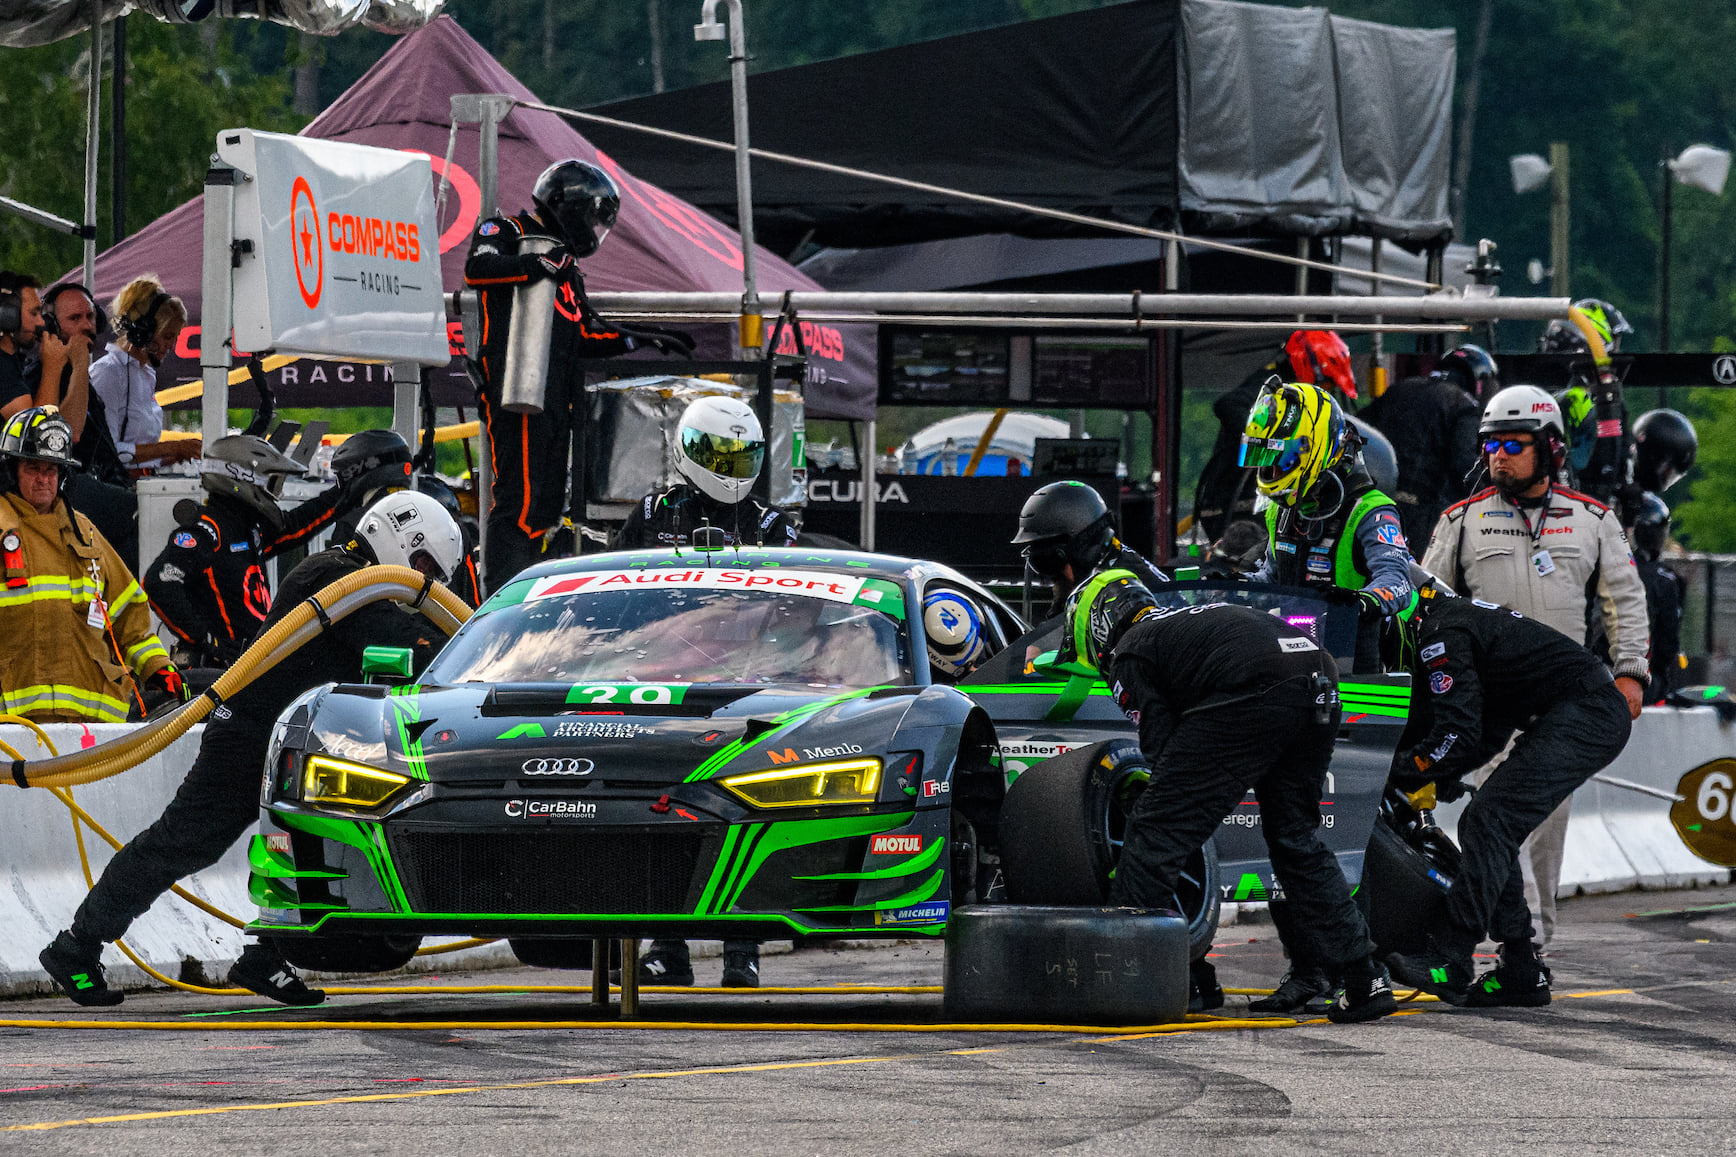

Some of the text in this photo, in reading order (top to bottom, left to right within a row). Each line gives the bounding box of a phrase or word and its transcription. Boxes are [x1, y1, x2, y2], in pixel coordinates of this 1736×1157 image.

[328, 212, 420, 263] COMPASS
[361, 271, 399, 295] RACING
[808, 480, 909, 503] CURA
[600, 571, 847, 595] Audi Sport
[803, 742, 863, 760] Menlo
[528, 800, 597, 813] CarBahn
[1697, 771, 1736, 823] 6
[550, 811, 595, 819] motorsports
[873, 837, 921, 852] MOTUL
[898, 907, 945, 919] MICHELIN
